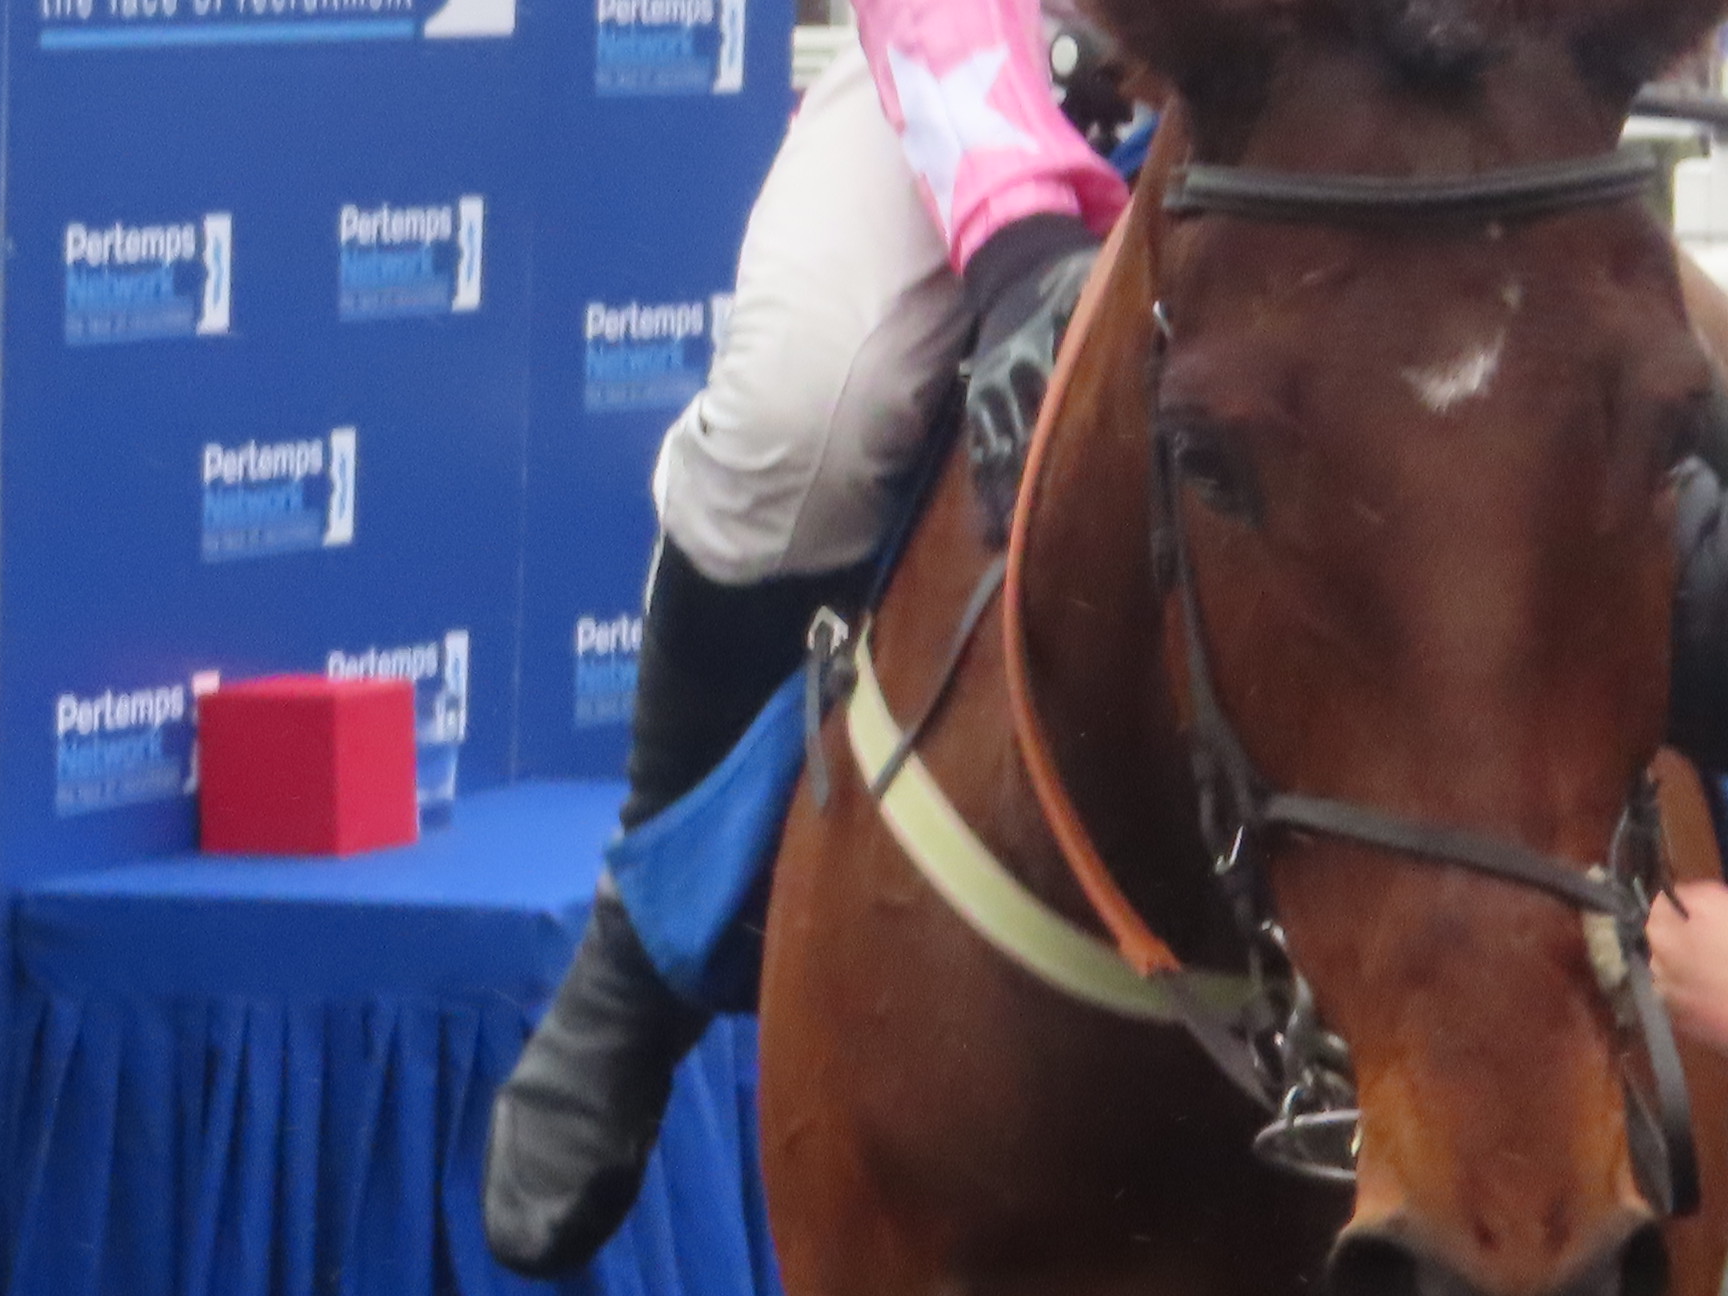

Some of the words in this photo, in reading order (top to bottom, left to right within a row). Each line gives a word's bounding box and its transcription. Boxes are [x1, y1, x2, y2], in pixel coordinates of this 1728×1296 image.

[66, 221, 196, 266] Pertemps
[339, 203, 452, 246] Pertemps
[586, 302, 704, 341] Pertemps
[202, 439, 324, 484] Pertemps
[57, 685, 185, 736] Pertemps
